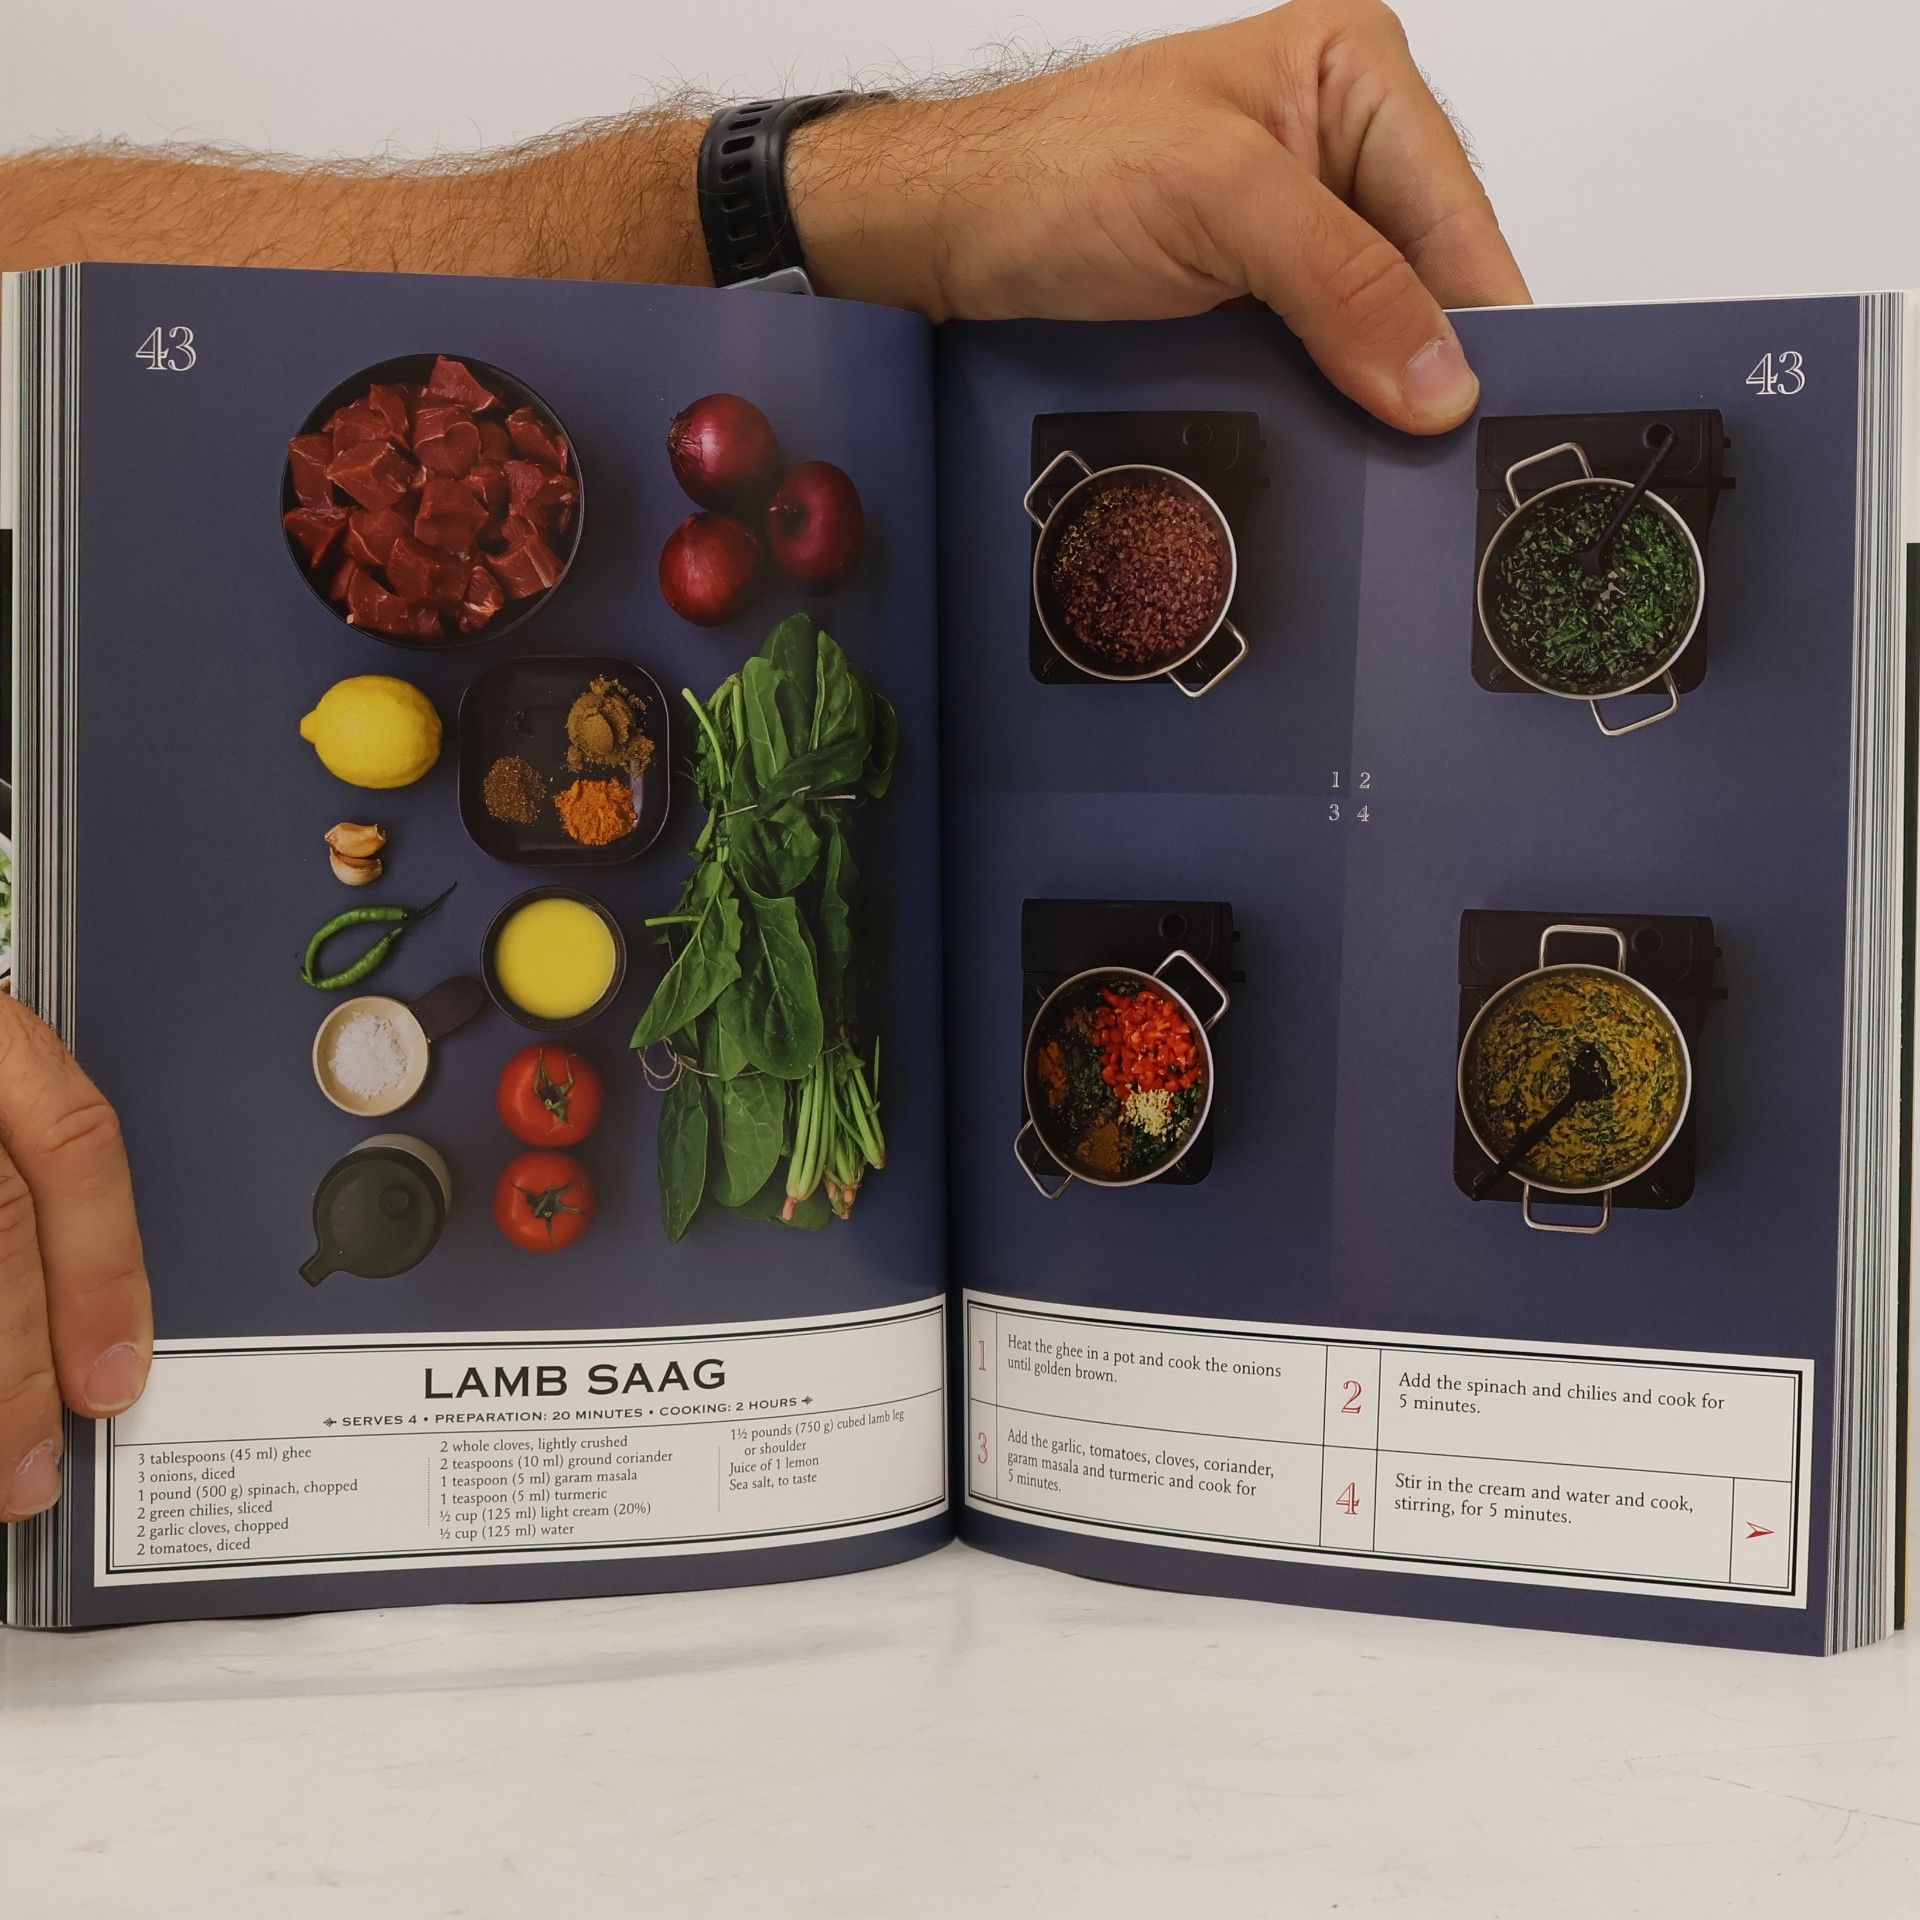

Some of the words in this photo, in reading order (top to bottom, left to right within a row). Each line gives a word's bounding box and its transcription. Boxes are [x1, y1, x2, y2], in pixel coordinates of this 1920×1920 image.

[135, 326, 197, 372] 43
[1745, 351, 1806, 395] 43
[1332, 771, 1340, 788] 1
[1359, 771, 1371, 789] 2
[1328, 803, 1340, 821] 3
[1356, 805, 1370, 822] 4
[978, 1340, 986, 1371] 1
[1008, 1334, 1032, 1351] Heat
[1034, 1338, 1053, 1355] the
[1055, 1341, 1083, 1360] ghee
[1086, 1345, 1099, 1360] in
[1102, 1351, 1109, 1361] a
[1113, 1352, 1137, 1367] pot
[1139, 1352, 1164, 1367] and
[1168, 1355, 1201, 1371] cook
[1204, 1356, 1228, 1373] the
[1232, 1361, 1281, 1377] onions
[424, 1365, 568, 1400] LAMB
[587, 1358, 726, 1395] SAAG
[1008, 1356, 1031, 1371] until
[1034, 1359, 1071, 1377] golden
[1075, 1363, 1117, 1383] brown.
[1341, 1380, 1362, 1414] 2
[1398, 1372, 1433, 1391] Add
[1435, 1374, 1462, 1393] the
[1466, 1378, 1527, 1397] spinach
[1532, 1382, 1562, 1398] and
[1567, 1383, 1617, 1402] chilies
[1622, 1388, 1652, 1405] and
[1657, 1391, 1697, 1408] cook
[1701, 1392, 1725, 1409] for
[342, 1415, 403, 1427] SERVES
[408, 1415, 417, 1424] 4
[435, 1411, 547, 1424] PREPARATION:
[552, 1411, 571, 1421] 20
[575, 1408, 643, 1420] MINUTES
[659, 1403, 731, 1416] COOKING:
[735, 1401, 744, 1412] 2
[749, 1397, 797, 1411] HOURS
[1399, 1393, 1407, 1408] 5
[1413, 1395, 1480, 1414] minutes.
[751, 1423, 792, 1442] pounds
[795, 1420, 821, 1437] (750
[823, 1418, 834, 1434] g)
[836, 1414, 866, 1429] cubed
[868, 1410, 891, 1425] lamb
[892, 1409, 904, 1423] leg
[138, 1453, 145, 1466] 3
[150, 1451, 226, 1467] tablespoons
[230, 1448, 251, 1463] (45
[256, 1446, 278, 1462] ml)
[282, 1445, 312, 1463] ghee
[440, 1440, 449, 1453] 2
[452, 1439, 490, 1453] whole
[493, 1438, 534, 1454] cloves,
[538, 1436, 578, 1455] lightly
[580, 1435, 628, 1449] crushed
[744, 1446, 757, 1456] or
[759, 1439, 807, 1455] shoulder
[978, 1432, 988, 1464] 3
[1007, 1428, 1029, 1449] Add
[1031, 1432, 1048, 1449] the
[1051, 1438, 1086, 1458] garlic,
[1089, 1444, 1151, 1466] tomatoes,
[1155, 1450, 1199, 1472] cloves,
[1203, 1458, 1274, 1479] coriander,
[440, 1458, 448, 1470] 2
[452, 1455, 514, 1473] teaspoons
[517, 1454, 539, 1470] (10
[542, 1453, 564, 1469] ml)
[567, 1452, 612, 1470] ground
[616, 1450, 673, 1464] coriander
[728, 1461, 757, 1477] Juice
[760, 1458, 774, 1471] of
[775, 1458, 781, 1470] 1
[785, 1455, 819, 1469] lemon
[1008, 1451, 1038, 1468] garam
[1041, 1458, 1079, 1474] masala
[1082, 1463, 1105, 1478] and
[1109, 1467, 1165, 1486] turmeric
[1168, 1474, 1194, 1489] and
[1197, 1477, 1233, 1494] cook
[1236, 1479, 1257, 1496] for
[138, 1471, 145, 1484] 3
[149, 1468, 199, 1486] onions,
[201, 1466, 235, 1483] diced
[440, 1475, 446, 1487] 1
[452, 1476, 508, 1490] teaspoon
[512, 1472, 525, 1487] (5
[529, 1470, 551, 1487] ml)
[552, 1469, 593, 1488] garam
[596, 1468, 638, 1482] masala
[729, 1478, 748, 1491] Sea
[752, 1476, 774, 1489] salt,
[778, 1476, 789, 1486] to
[792, 1473, 817, 1485] taste
[1008, 1468, 1014, 1482] 5
[1017, 1471, 1061, 1492] minutes.
[138, 1489, 144, 1502] 1
[149, 1486, 193, 1504] pound
[196, 1484, 227, 1501] (500
[229, 1484, 243, 1501] g)
[247, 1481, 300, 1500] spinach,
[304, 1478, 358, 1496] chopped
[440, 1493, 446, 1505] 1
[452, 1493, 508, 1507] teaspoon
[512, 1489, 525, 1505] (5
[529, 1488, 551, 1505] ml)
[554, 1487, 608, 1503] turmeric
[1335, 1482, 1360, 1515] 4
[1395, 1472, 1423, 1490] Stir
[1426, 1475, 1443, 1492] in
[1447, 1477, 1473, 1494] the
[1478, 1484, 1527, 1503] cream
[1529, 1485, 1561, 1505] and
[1566, 1490, 1611, 1505] water
[1615, 1491, 1645, 1508] and
[1650, 1495, 1693, 1514] cook,
[137, 1507, 146, 1519] 2
[149, 1508, 185, 1523] green
[189, 1502, 233, 1519] chilies,
[237, 1500, 273, 1515] sliced
[454, 1512, 478, 1525] cup
[482, 1507, 512, 1523] (125
[513, 1506, 537, 1521] ml)
[540, 1505, 570, 1522] light
[572, 1507, 609, 1517] cream
[613, 1501, 651, 1517] (20%)
[1394, 1495, 1455, 1518] stirring,
[1460, 1499, 1484, 1516] for
[1489, 1502, 1498, 1517] 5
[1504, 1505, 1572, 1524] minutes.
[136, 1525, 147, 1540] 2
[149, 1523, 185, 1541] garlic
[188, 1521, 231, 1535] cloves,
[233, 1517, 289, 1535] chopped
[454, 1530, 478, 1542] cup
[482, 1524, 511, 1540] (125
[514, 1523, 536, 1538] ml)
[540, 1523, 575, 1536] water
[136, 1543, 146, 1556] 2
[149, 1540, 212, 1555] tomatoes,
[216, 1536, 251, 1551] diced
